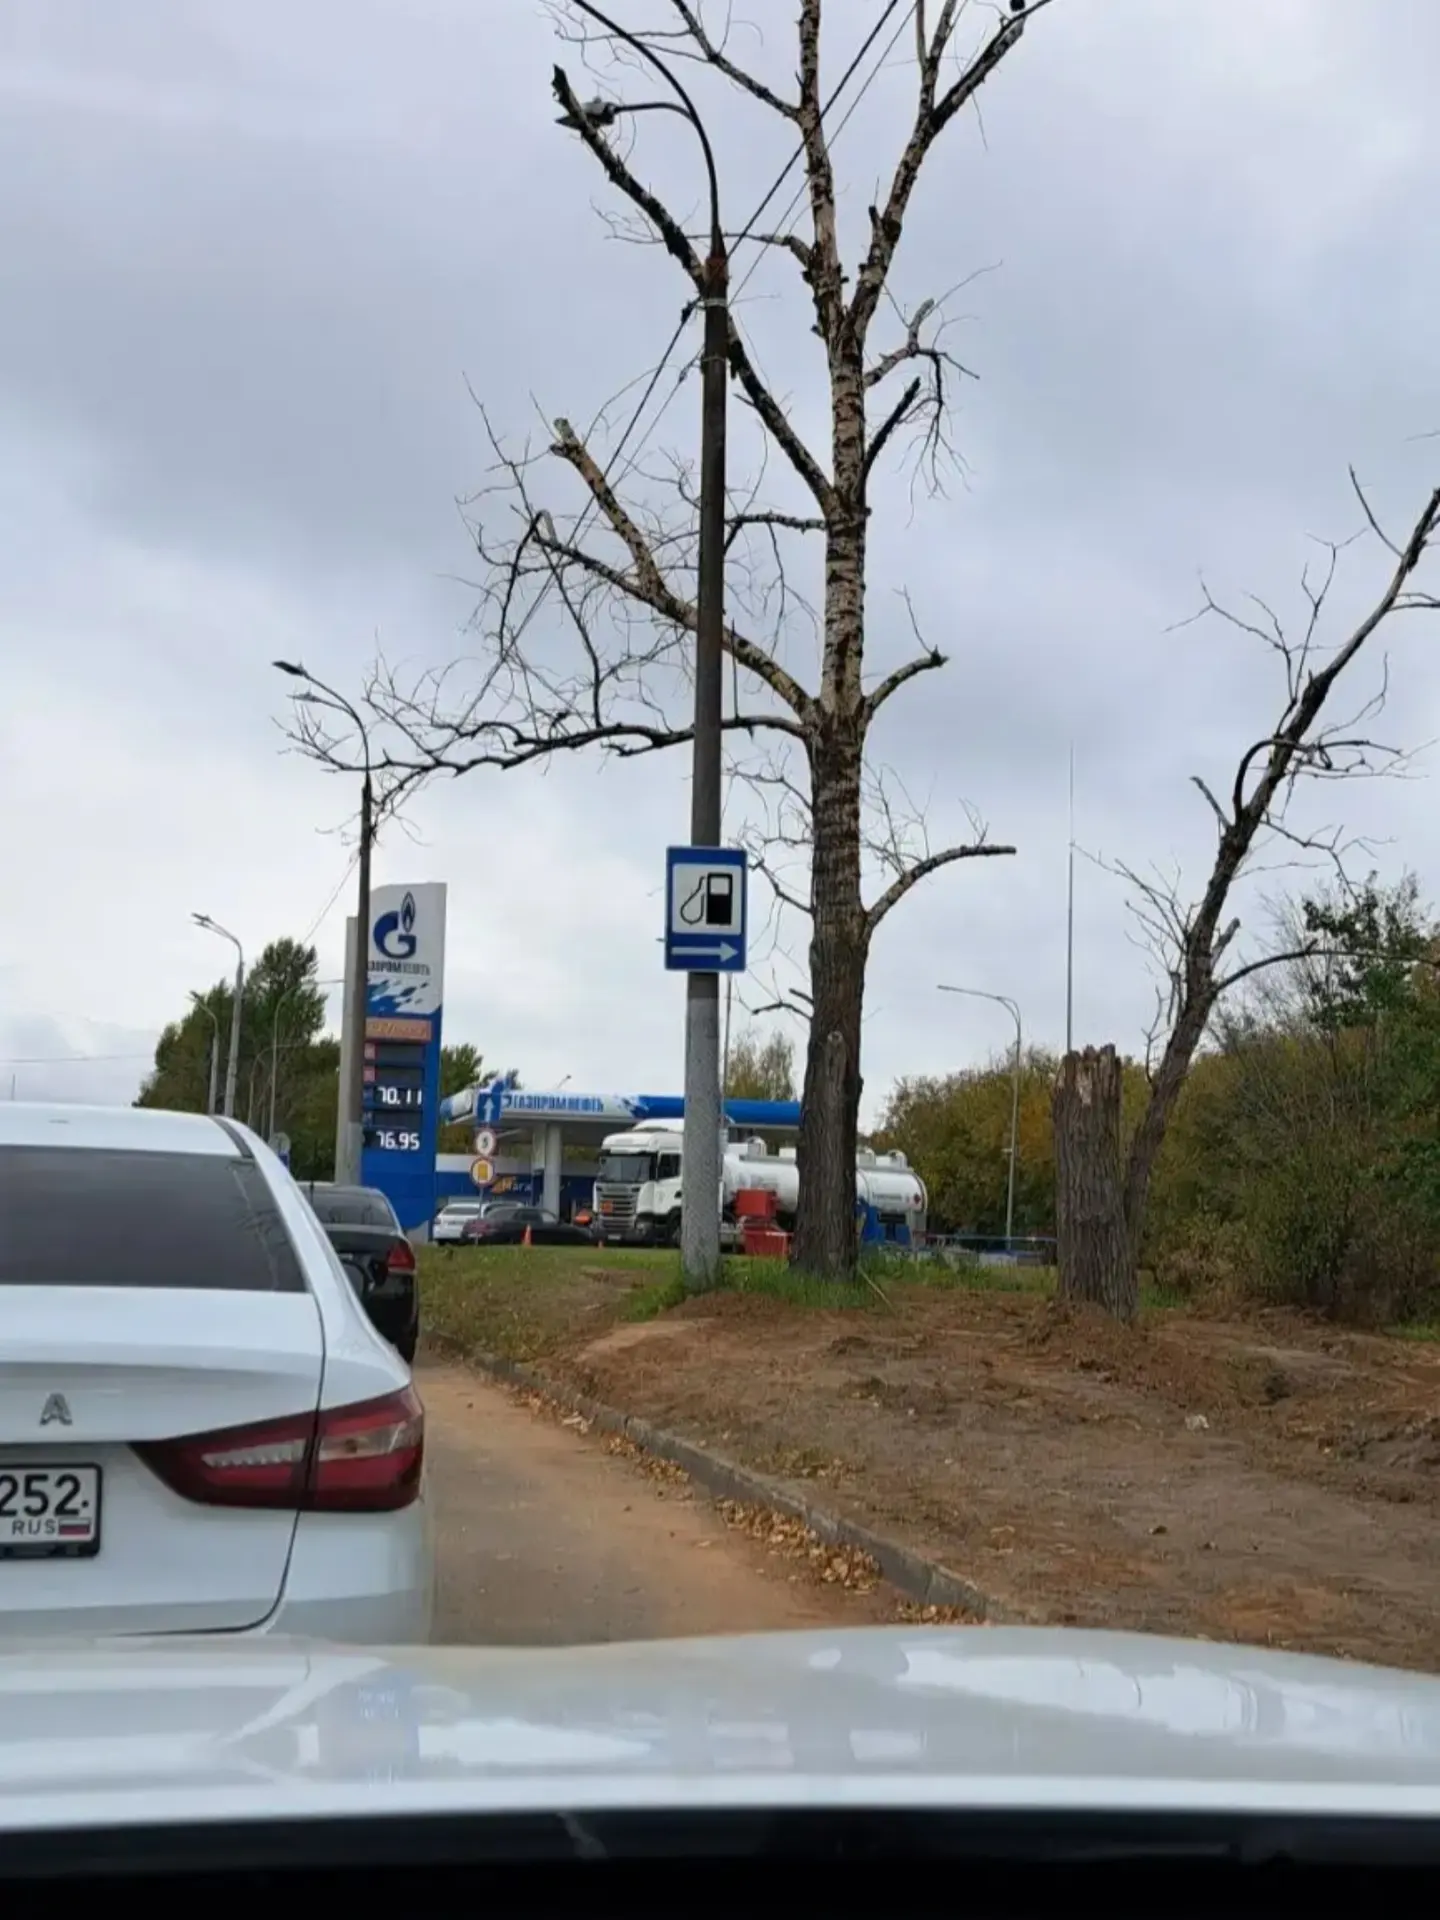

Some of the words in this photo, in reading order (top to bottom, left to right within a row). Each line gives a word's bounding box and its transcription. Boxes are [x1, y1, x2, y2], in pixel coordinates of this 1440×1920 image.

[378, 1086, 422, 1105] 70.11
[376, 1130, 420, 1150] 76.95
[12, 1519, 57, 1536] RUS
